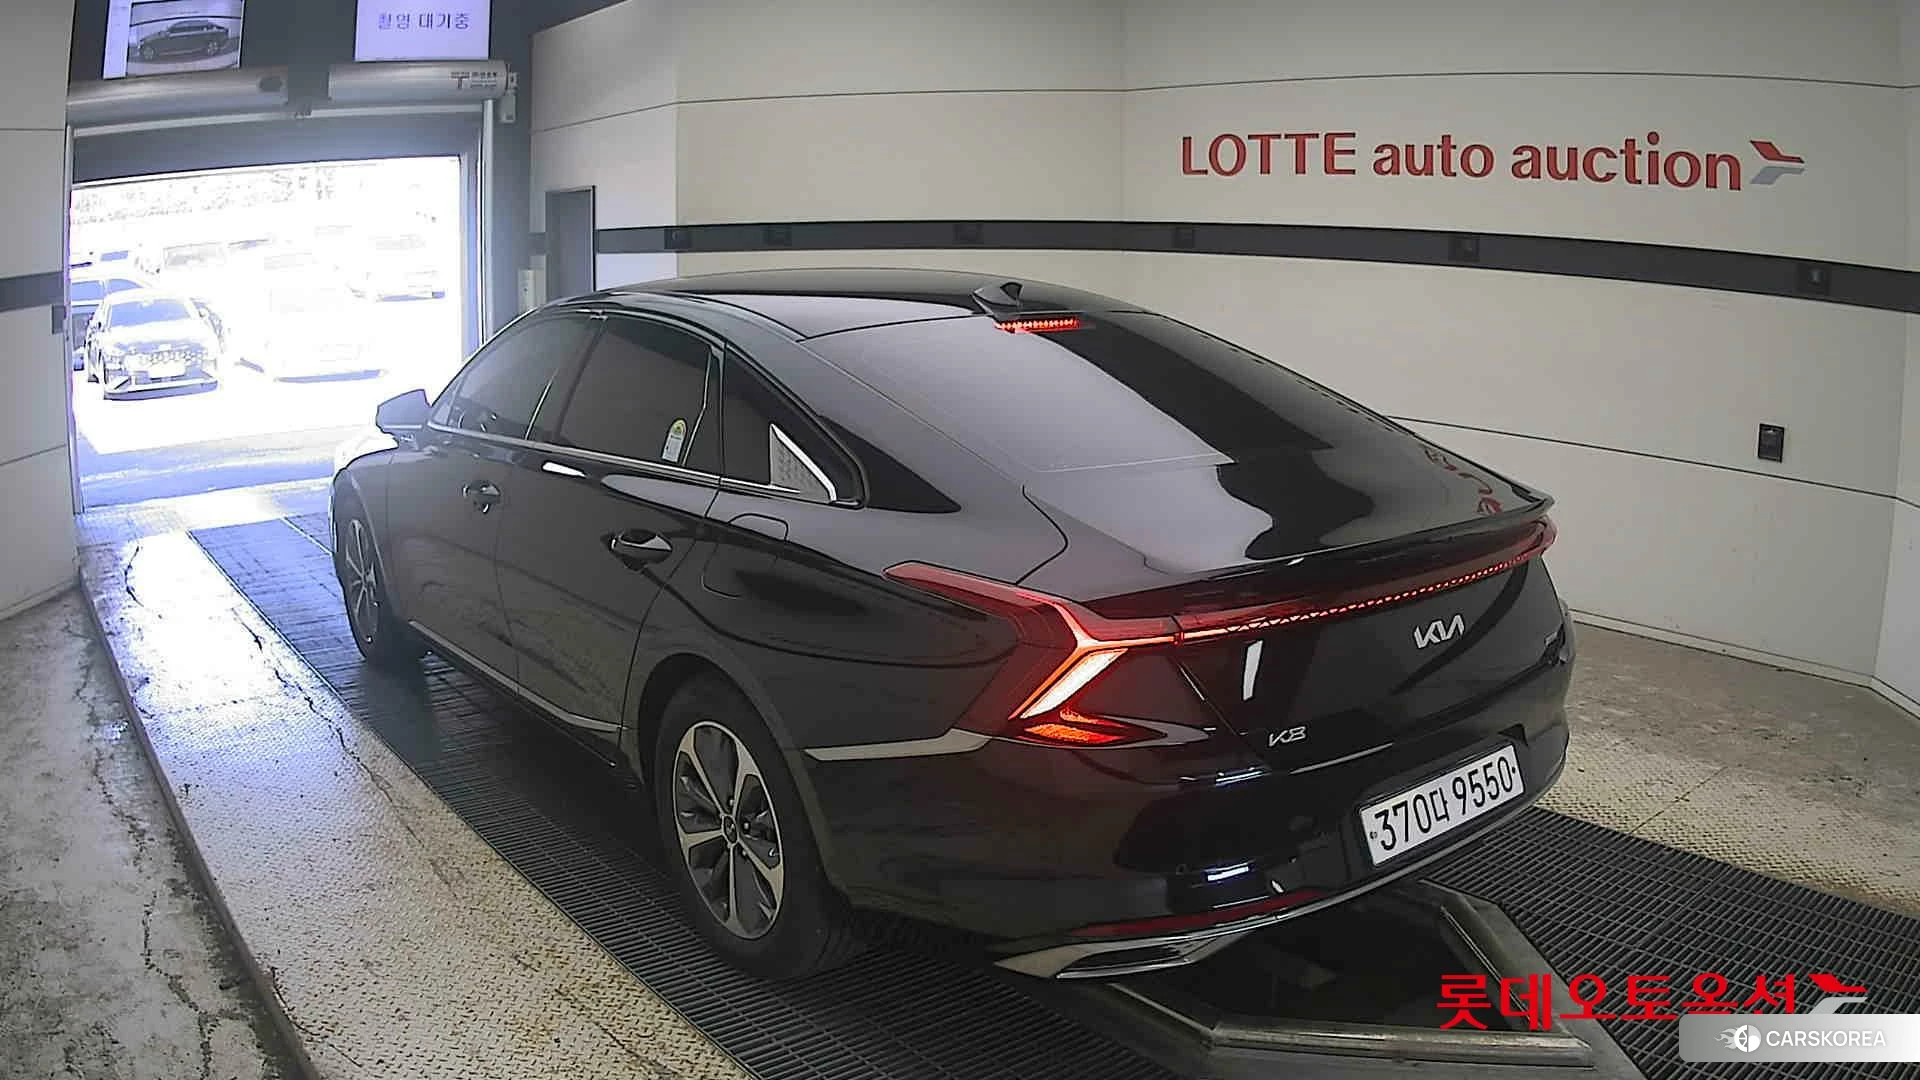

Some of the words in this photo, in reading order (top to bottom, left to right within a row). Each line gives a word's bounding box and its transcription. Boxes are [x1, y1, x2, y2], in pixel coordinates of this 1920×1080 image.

[419, 12, 469, 30] 대기중
[1181, 132, 1357, 176] LOTTE
[1372, 134, 1495, 178] auto
[1511, 131, 1742, 191] auction
[1413, 614, 1465, 649] KIA
[1268, 726, 1307, 747] K8
[1373, 786, 1450, 851] 370다
[1452, 755, 1514, 816] 9550
